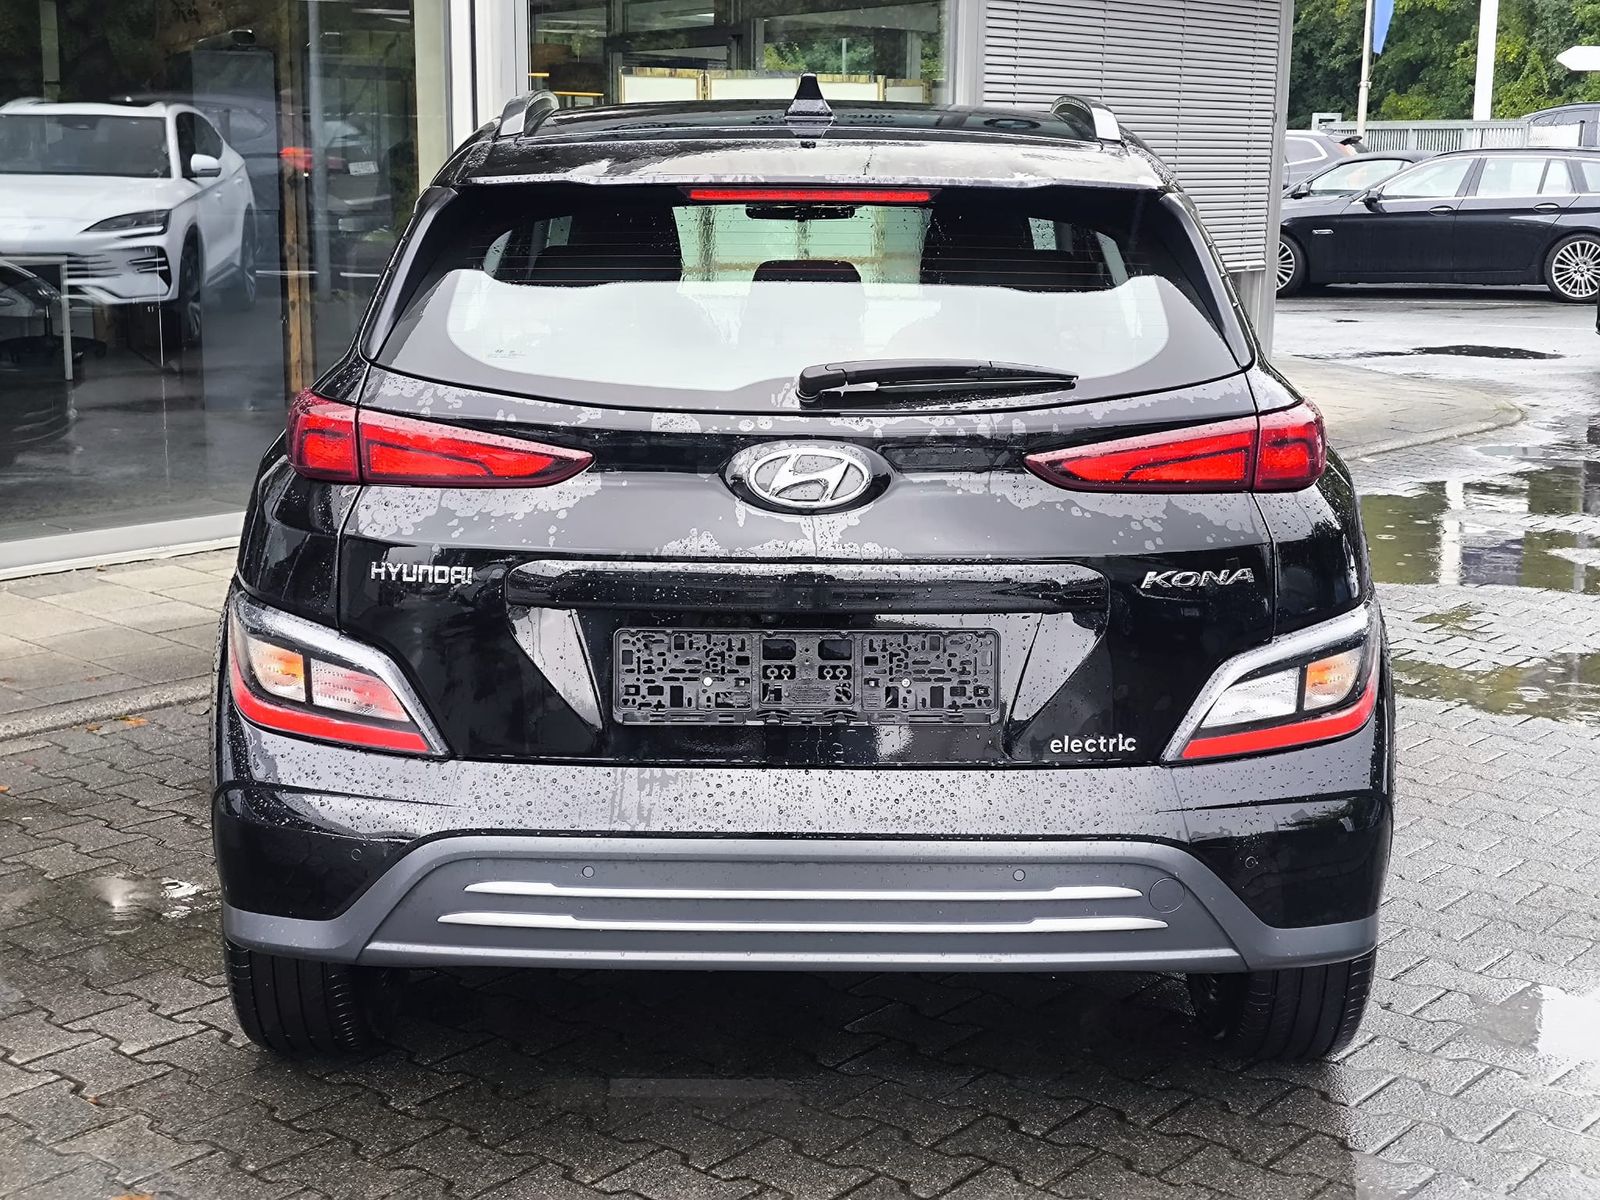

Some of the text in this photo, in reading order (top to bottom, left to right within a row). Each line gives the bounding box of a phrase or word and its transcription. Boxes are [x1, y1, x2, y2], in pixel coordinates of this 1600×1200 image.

[370, 561, 474, 585] HYUNDAI
[1140, 567, 1255, 589] KONA
[1050, 733, 1137, 753] electric
